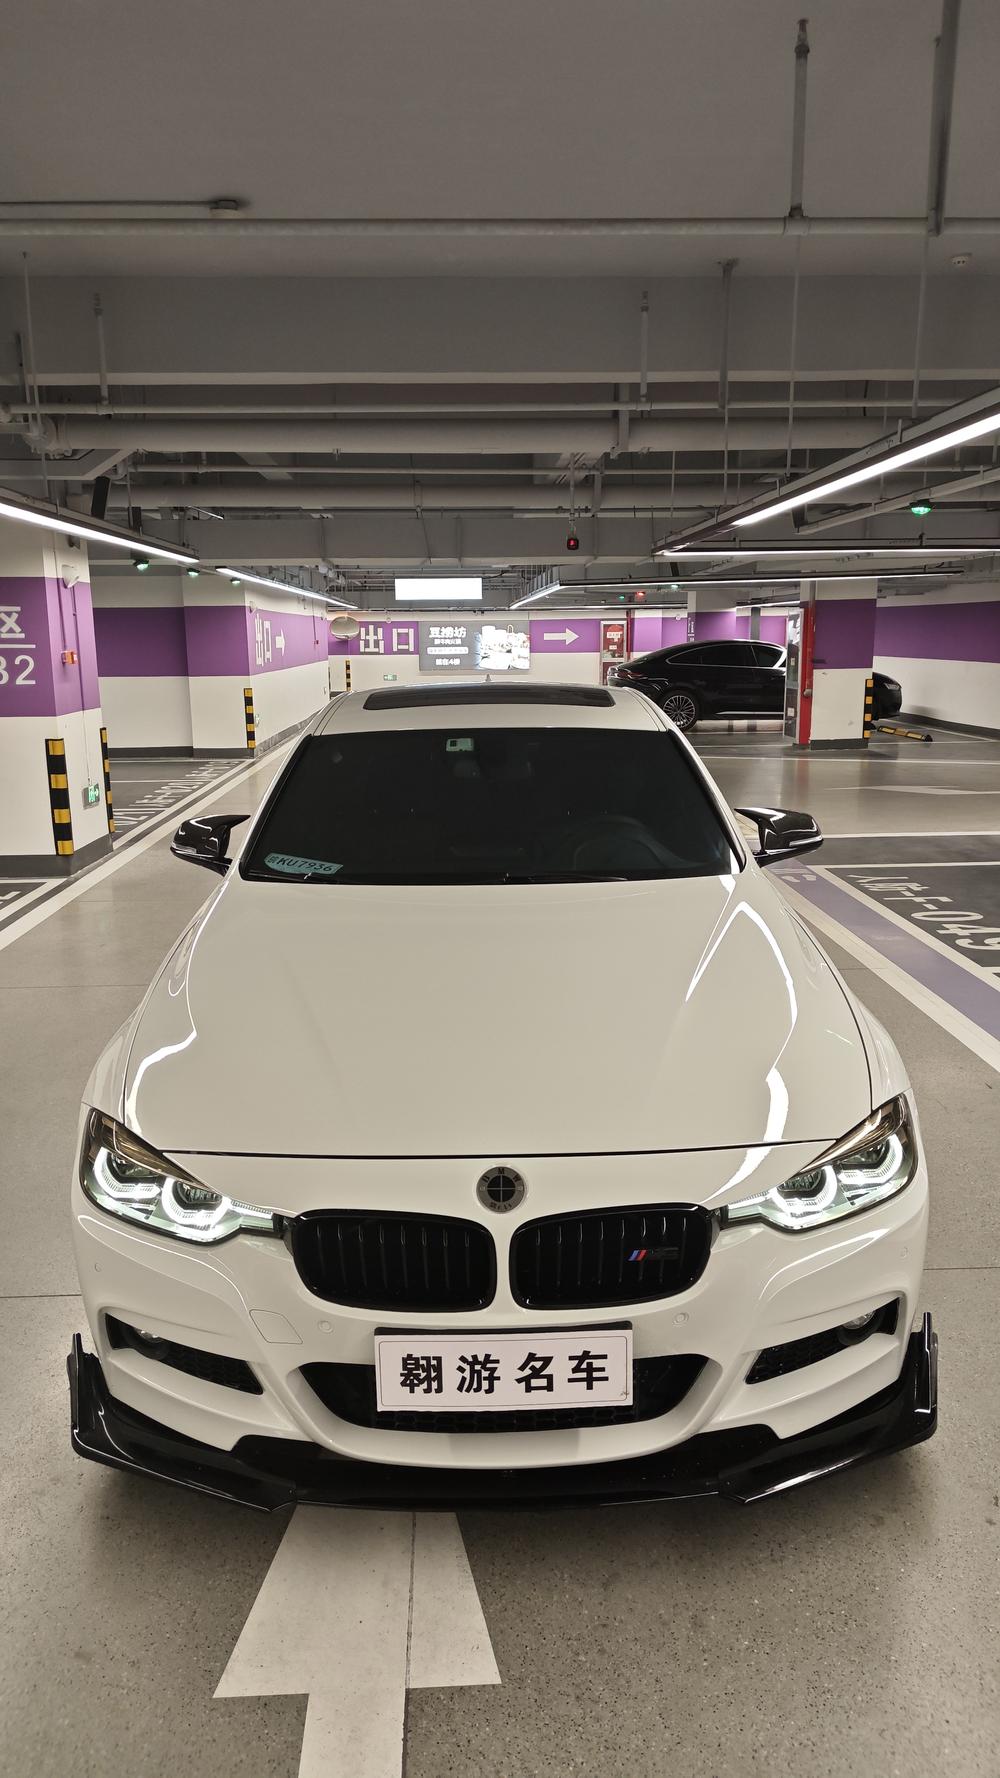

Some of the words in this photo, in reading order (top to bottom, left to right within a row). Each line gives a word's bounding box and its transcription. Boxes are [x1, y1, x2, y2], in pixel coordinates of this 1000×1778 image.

[255, 613, 272, 667] 出口
[360, 624, 415, 654] 出口
[400, 1350, 609, 1394] 翱游名车
